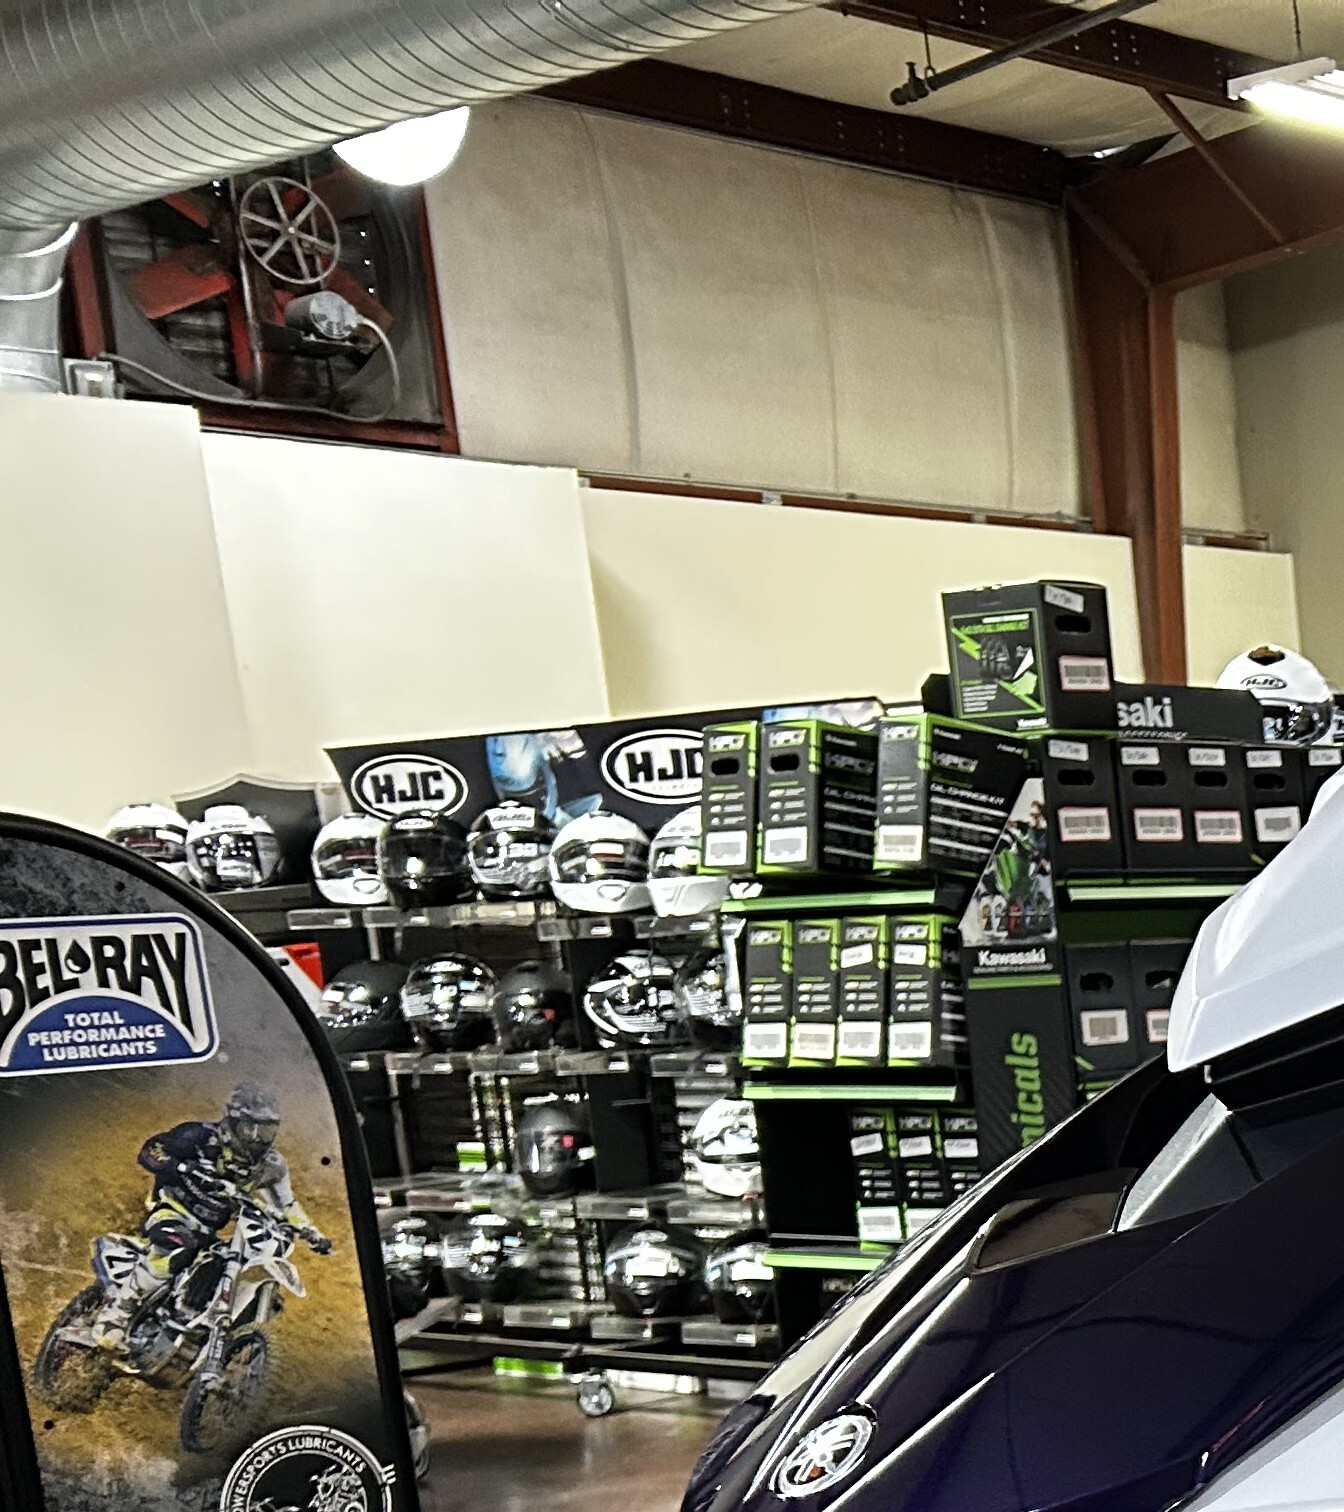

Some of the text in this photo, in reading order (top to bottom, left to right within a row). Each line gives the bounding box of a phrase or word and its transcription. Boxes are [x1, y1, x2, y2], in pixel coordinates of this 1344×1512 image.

[625, 747, 703, 783] HJC
[370, 768, 444, 805] HJC
[64, 1010, 125, 1028] TOTAL
[27, 1023, 167, 1047] PERFORMANCE
[42, 1040, 158, 1062] LUBRICANTS
[287, 1436, 367, 1474] LUBRICANTS
